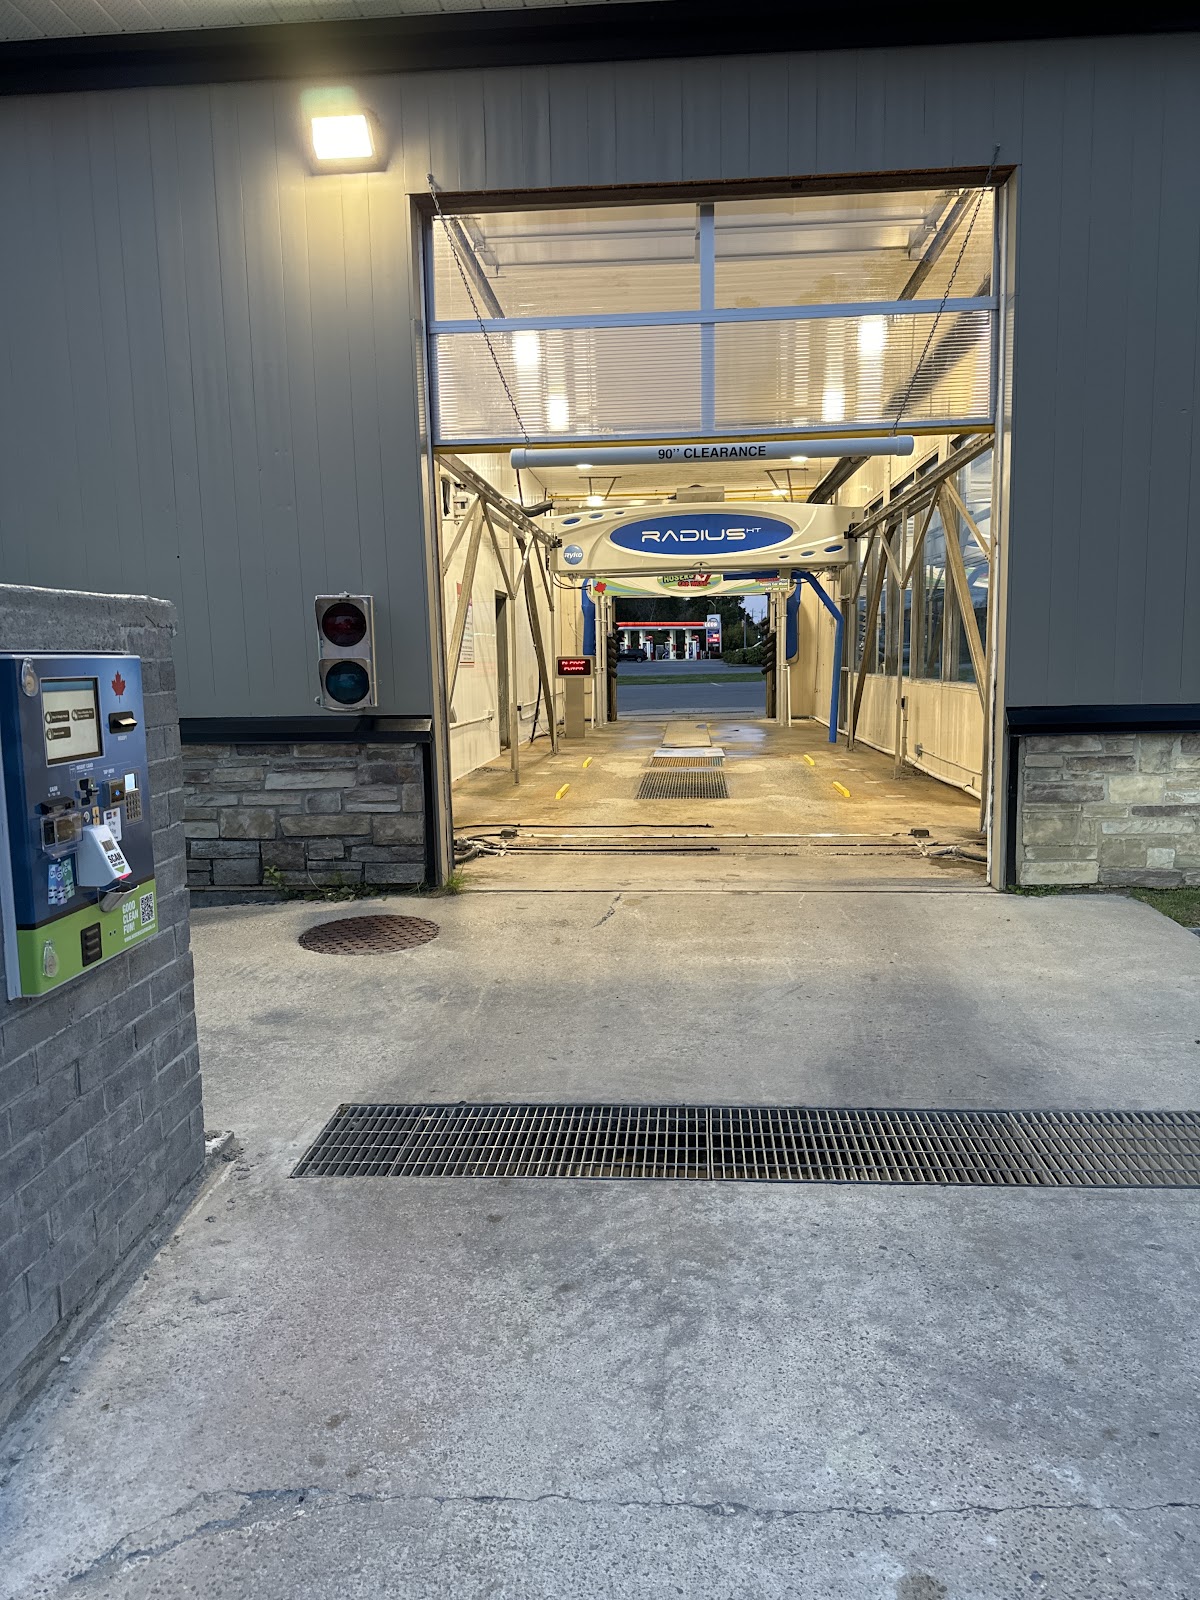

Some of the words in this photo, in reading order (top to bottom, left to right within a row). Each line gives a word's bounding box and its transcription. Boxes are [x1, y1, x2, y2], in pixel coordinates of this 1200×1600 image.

[684, 445, 767, 459] CLEARANCE
[641, 528, 746, 543] RADIUS
[107, 851, 123, 864] SCAN
[122, 900, 136, 914] GOOD
[122, 909, 139, 925] CLEAN
